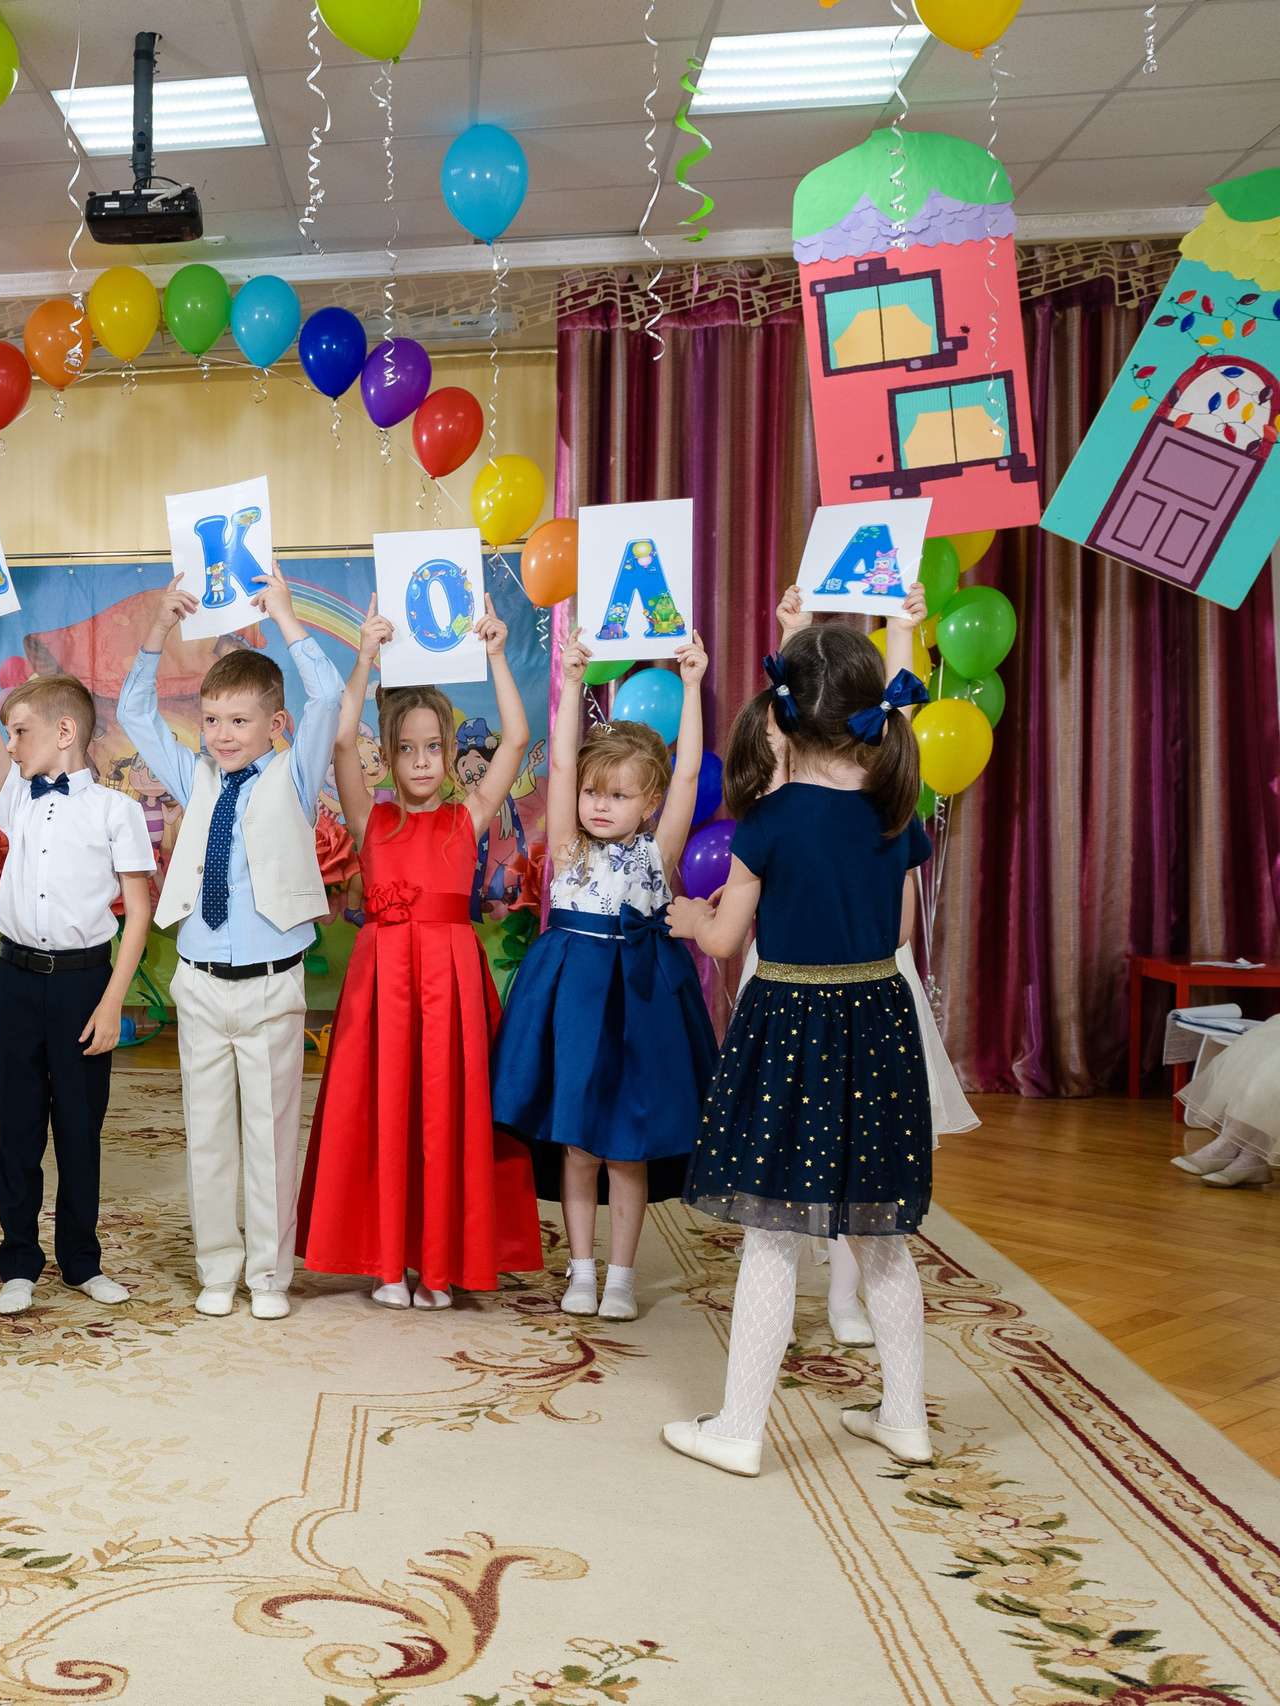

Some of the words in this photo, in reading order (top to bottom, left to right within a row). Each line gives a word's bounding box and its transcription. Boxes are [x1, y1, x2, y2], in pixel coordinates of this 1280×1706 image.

[194, 506, 269, 609] К
[813, 524, 908, 600] А
[405, 558, 474, 653] О
